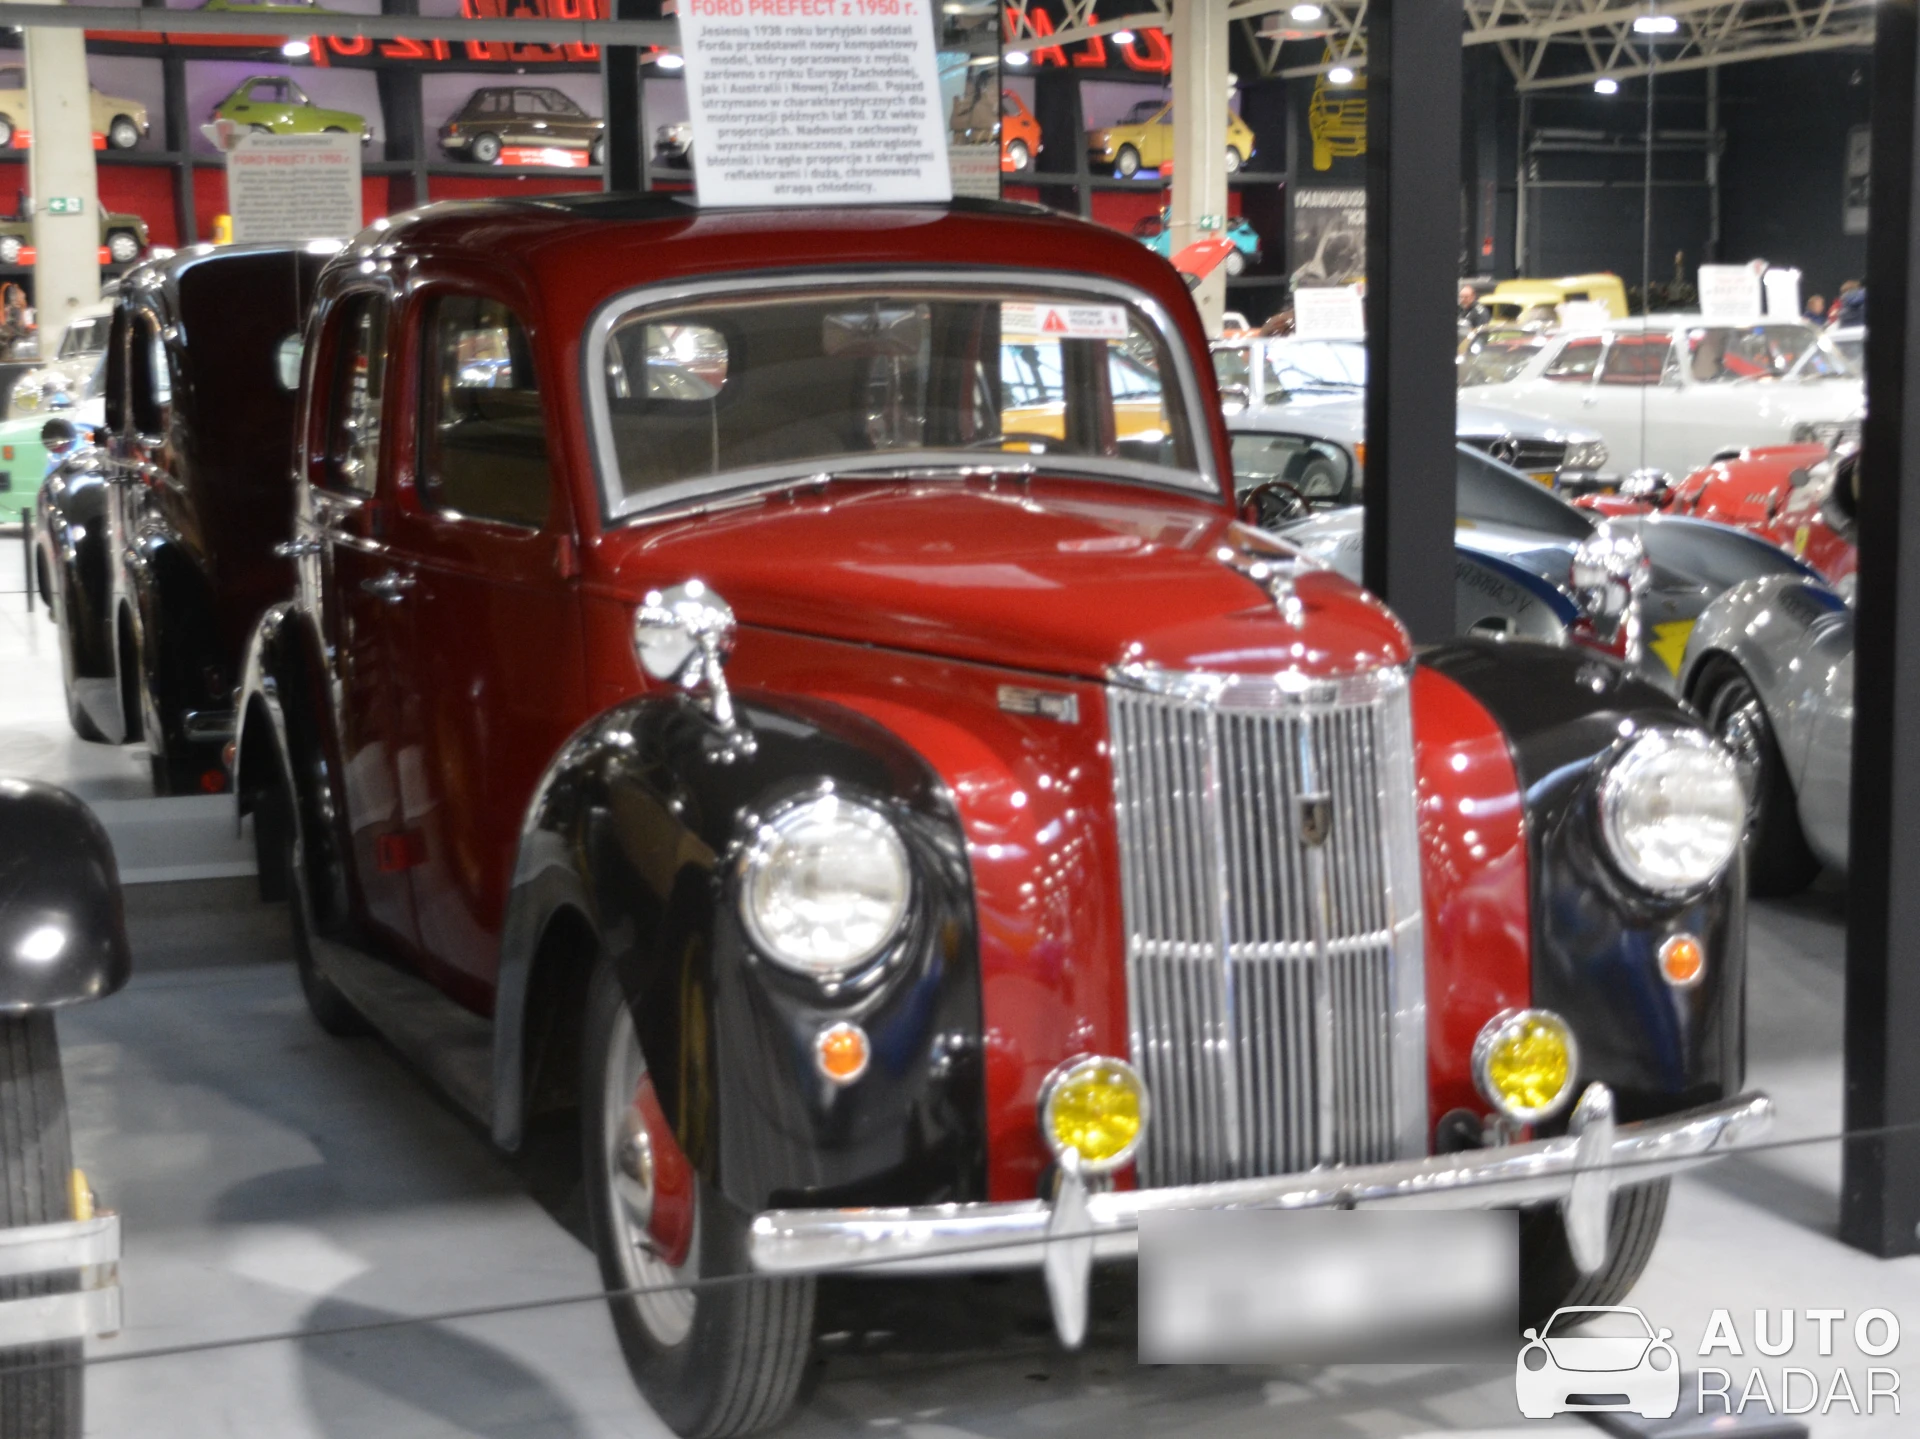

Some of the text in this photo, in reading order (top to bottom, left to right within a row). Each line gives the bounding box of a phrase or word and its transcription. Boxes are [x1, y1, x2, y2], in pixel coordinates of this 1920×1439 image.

[690, 0, 919, 16] FORD PREFECT z 1950 r.
[754, 25, 781, 36] 1938
[785, 26, 813, 36] roku
[815, 24, 867, 38] brytyjski
[698, 40, 733, 51] Forda
[809, 41, 840, 52] nowy
[843, 40, 918, 51] kompaktowy
[711, 55, 753, 66] model,
[755, 54, 787, 66] który
[790, 54, 862, 66] opracowano
[704, 69, 755, 80] zarówno
[758, 71, 767, 79] o
[769, 69, 803, 80] rynku
[806, 67, 848, 80] Europy
[701, 83, 719, 96] jak
[730, 83, 781, 94] Australii
[791, 82, 828, 95] Nowej
[885, 81, 924, 93] Pojazd
[769, 99, 780, 107] w
[783, 96, 906, 111] charakterystycznych
[908, 96, 927, 106] dla
[707, 112, 778, 125] motoryzacji
[832, 110, 847, 120] lat
[871, 110, 887, 120] XX
[890, 110, 926, 120] wieku
[796, 125, 854, 135] Nadwozie
[806, 153, 862, 166] proporcje
[865, 155, 873, 163] z
[724, 170, 800, 180] reflektorami
[845, 167, 921, 178] chromowaną
[774, 184, 813, 195] atrapą
